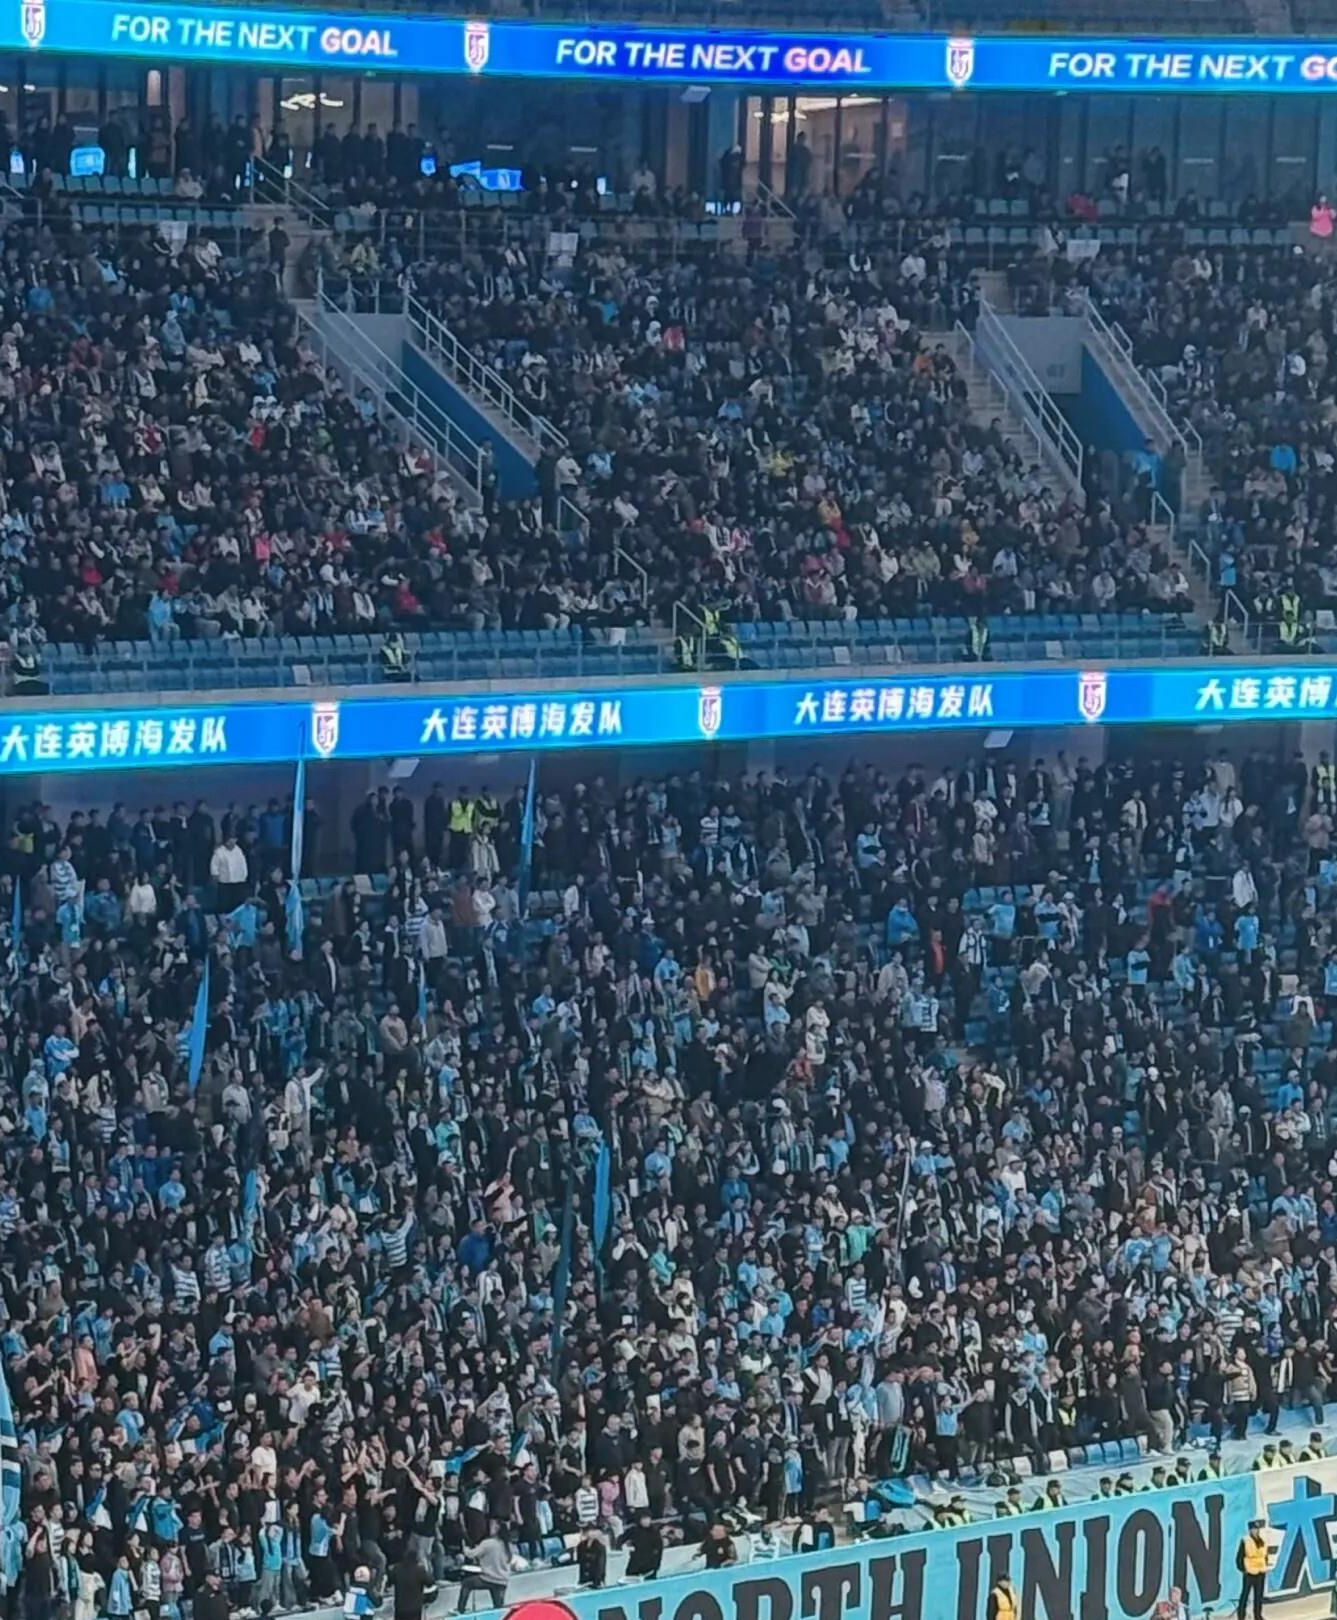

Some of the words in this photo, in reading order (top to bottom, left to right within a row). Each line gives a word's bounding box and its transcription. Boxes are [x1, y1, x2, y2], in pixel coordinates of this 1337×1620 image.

[111, 14, 169, 42] FOR
[177, 18, 233, 47] THE
[237, 22, 316, 52] NEXT
[320, 26, 398, 56] GOAL
[555, 39, 617, 66] FOR
[624, 41, 685, 68] THE
[691, 44, 778, 71] NEXT
[783, 46, 872, 73] GOAL
[1049, 52, 1115, 78] FOR
[1124, 53, 1194, 79] THE
[1198, 54, 1296, 81] NEXT
[794, 684, 994, 725] 大连英博海发队
[1194, 676, 1337, 711] 大连英博
[420, 700, 623, 743] 大连英博海发队
